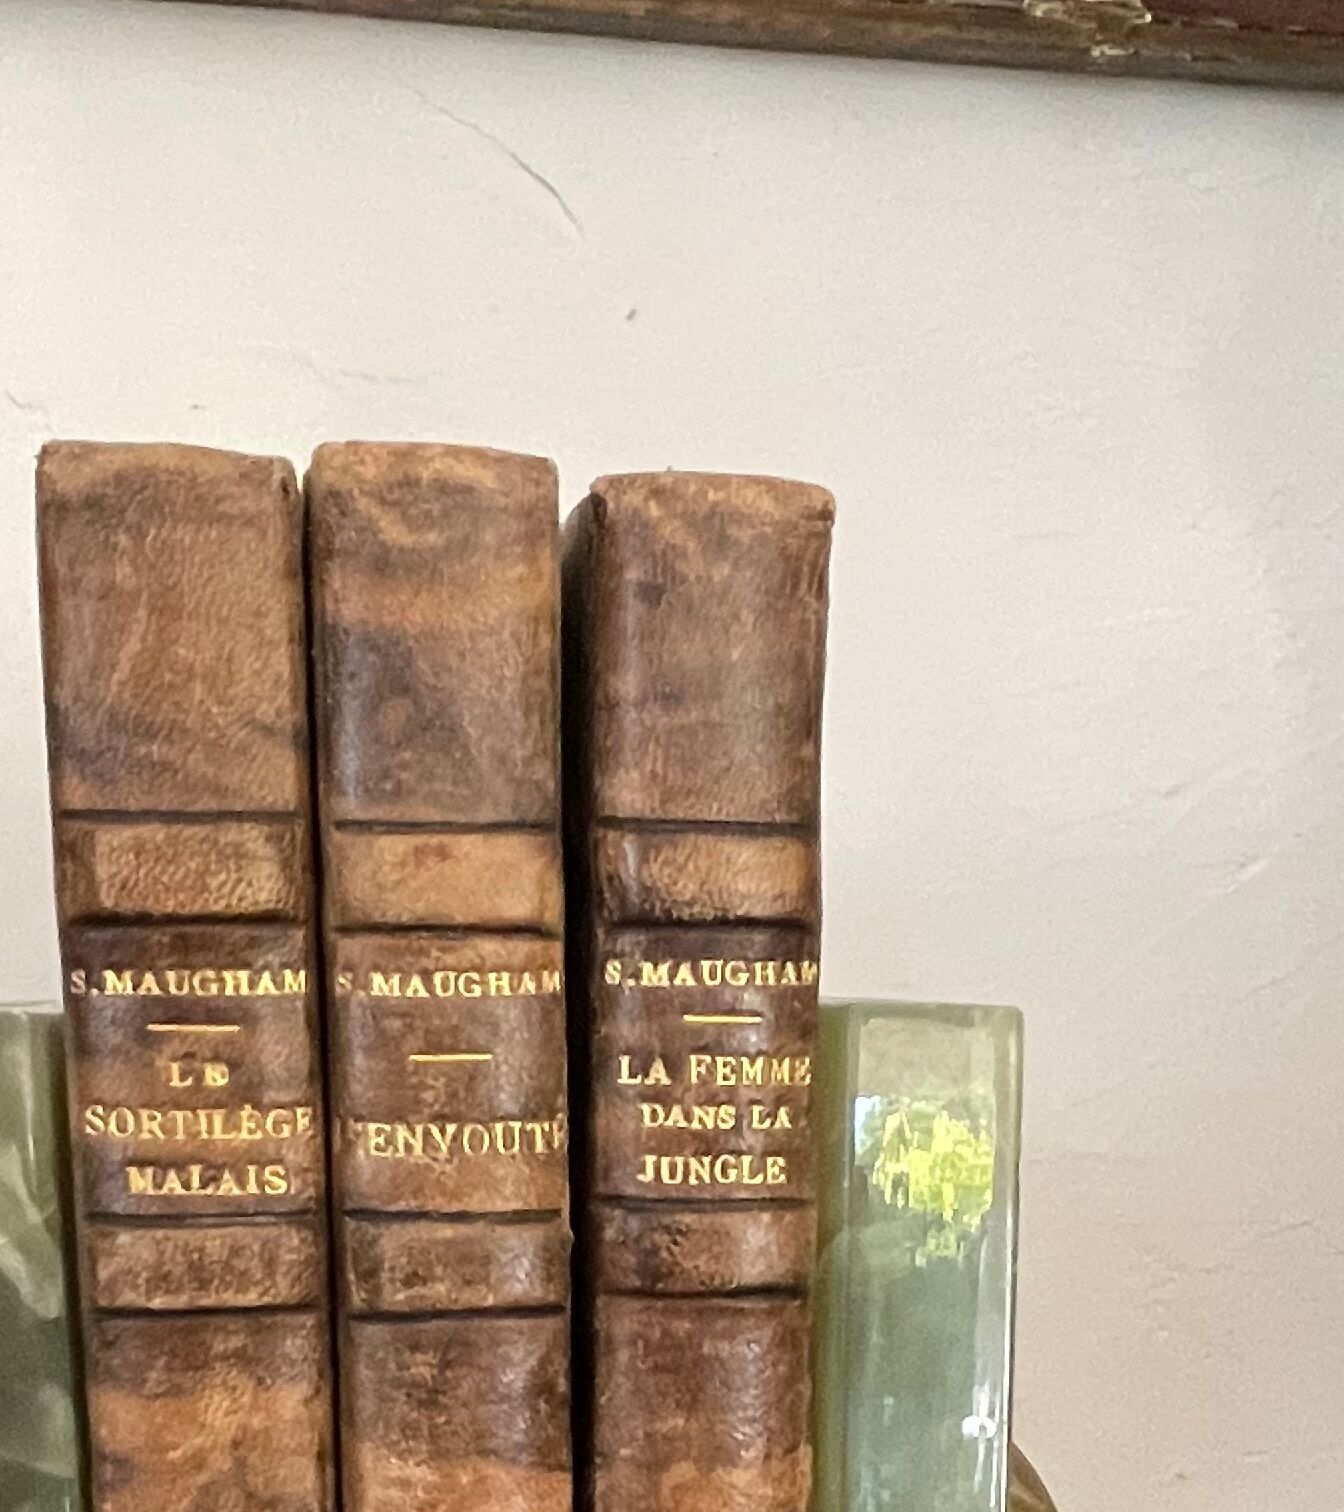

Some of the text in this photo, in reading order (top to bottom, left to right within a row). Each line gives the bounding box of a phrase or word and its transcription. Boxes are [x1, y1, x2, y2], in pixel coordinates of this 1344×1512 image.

[616, 1055, 812, 1087] LA FEMME
[640, 1103, 793, 1130] DANS LA
[125, 1164, 290, 1196] MALAIS
[636, 1154, 788, 1185] JUNGLE
